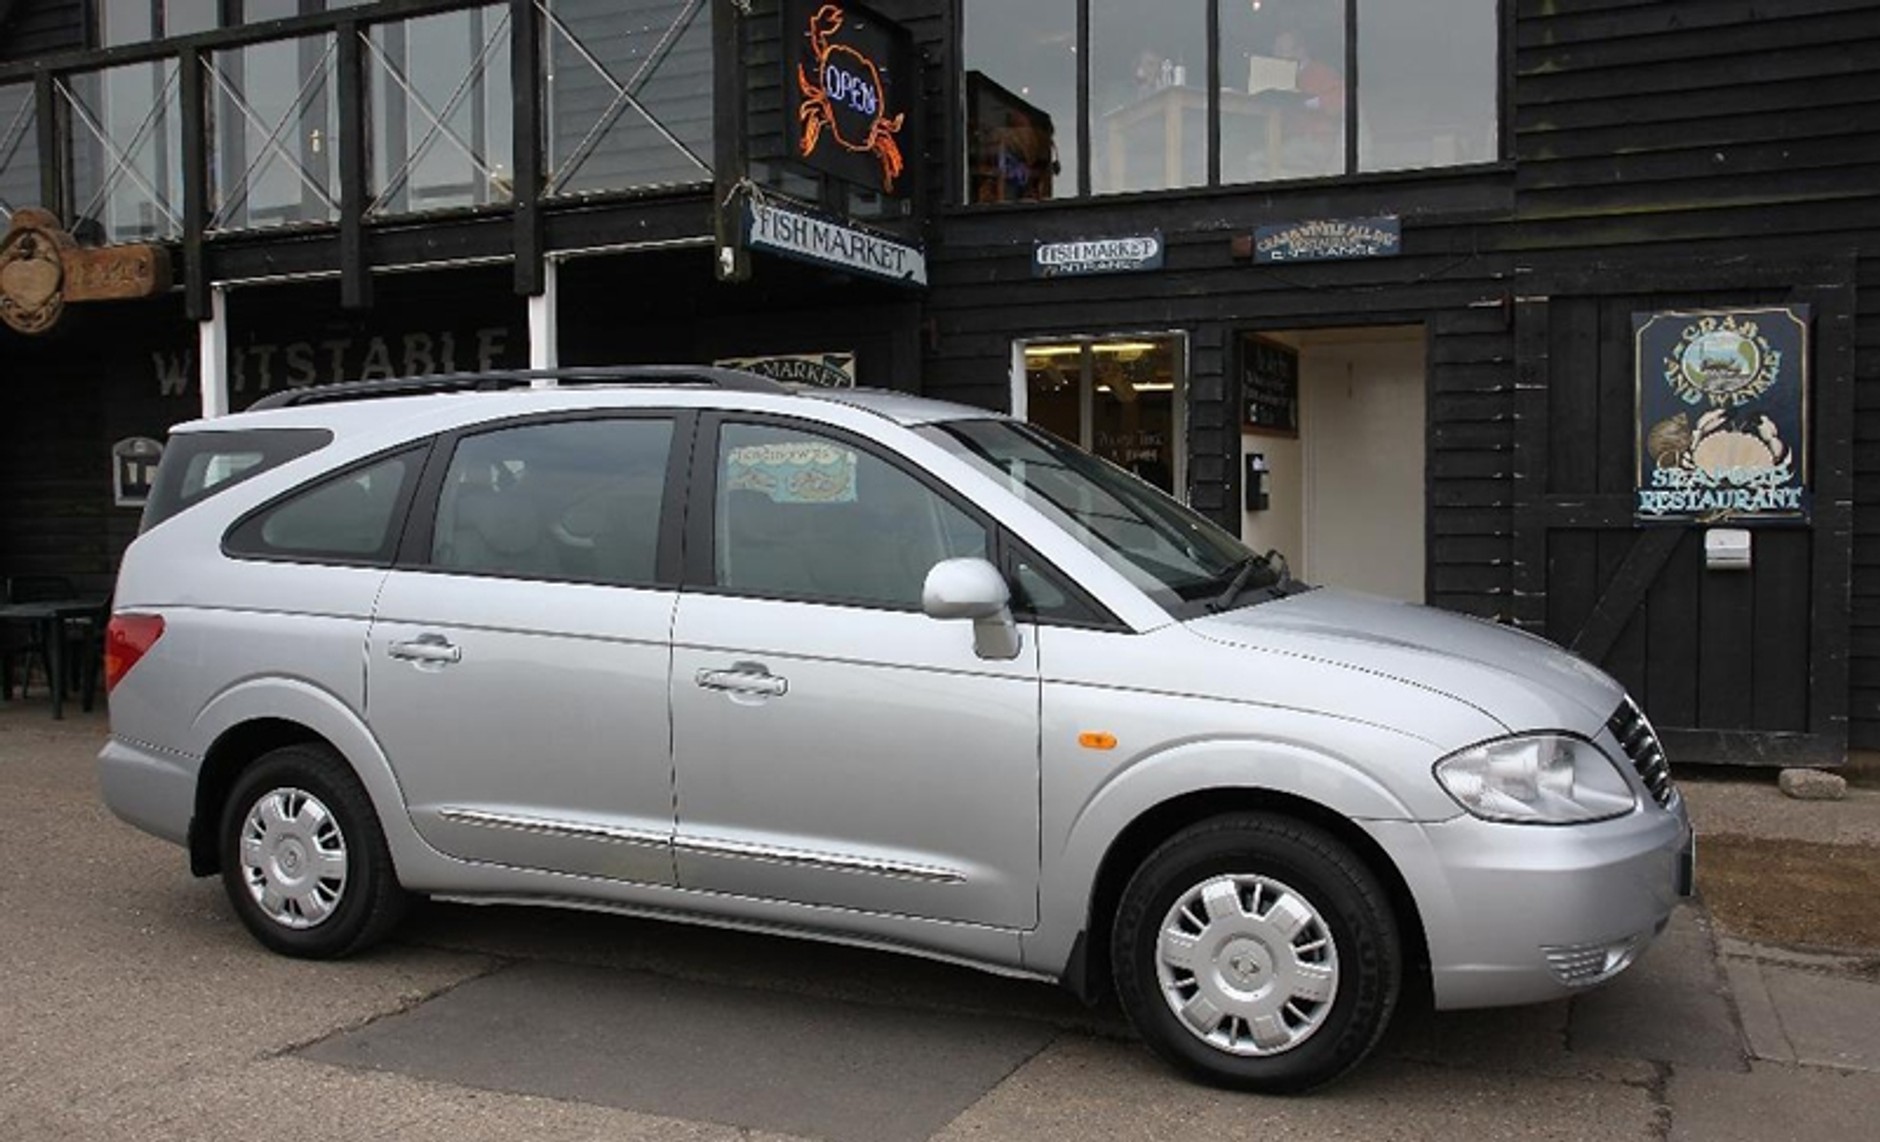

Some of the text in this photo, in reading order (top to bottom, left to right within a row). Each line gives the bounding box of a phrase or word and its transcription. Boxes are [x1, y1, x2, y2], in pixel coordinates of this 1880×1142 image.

[826, 65, 875, 114] OPEN
[760, 206, 907, 275] FISH MARKET
[1041, 240, 1150, 262] FISH MARKET
[153, 328, 509, 397] WITSTABLE
[763, 359, 846, 388] MARKET
[1639, 486, 1803, 515] RESTAURANT
